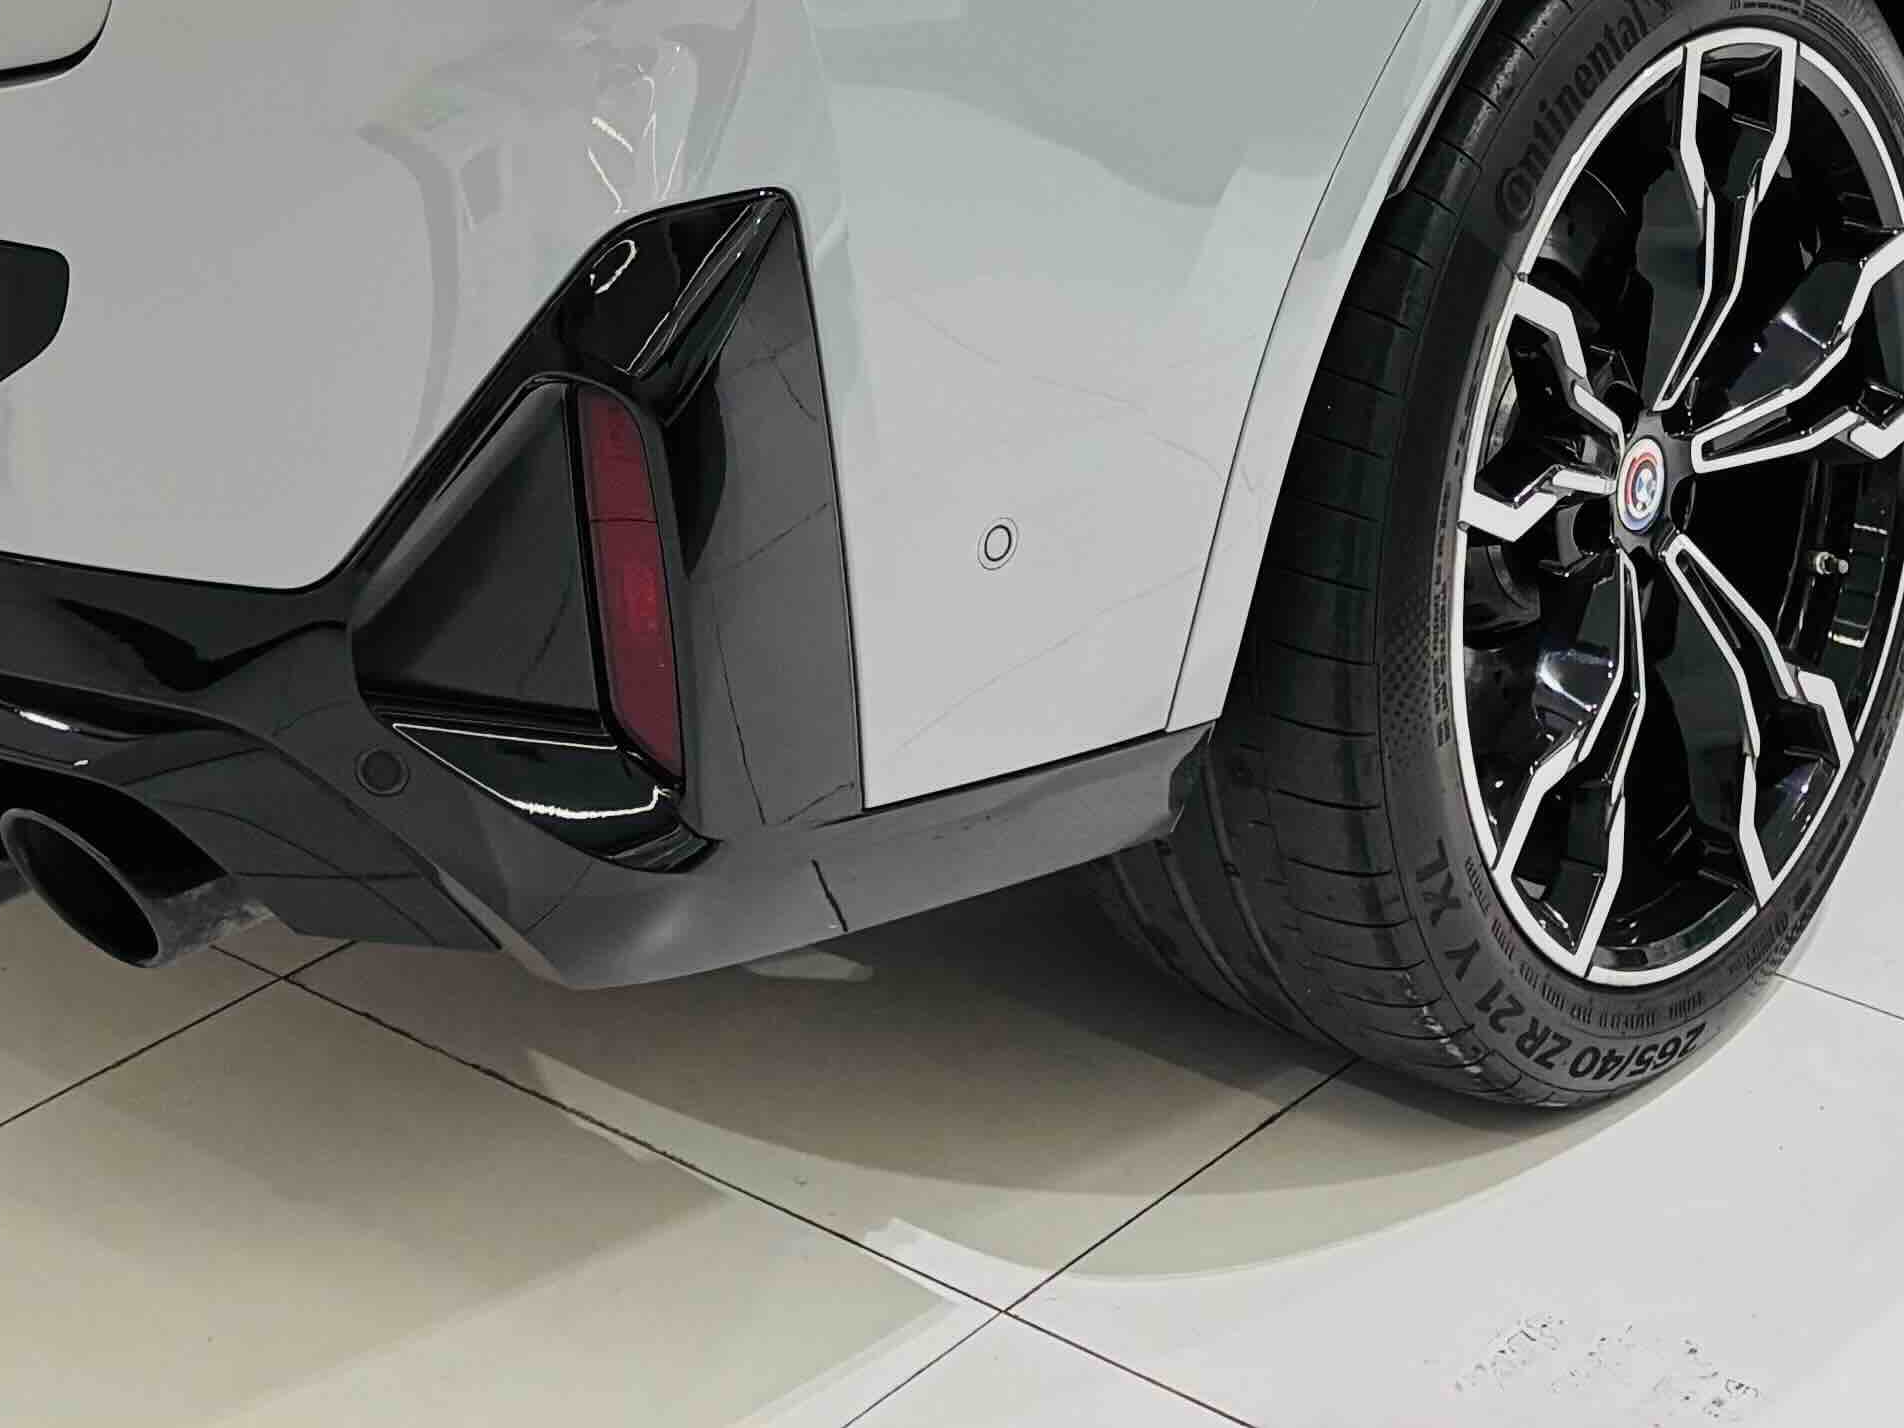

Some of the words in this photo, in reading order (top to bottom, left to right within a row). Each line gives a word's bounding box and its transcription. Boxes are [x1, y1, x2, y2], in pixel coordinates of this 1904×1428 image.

[1414, 838, 1463, 927] XL
[1474, 980, 1526, 1035] 21
[1514, 1015, 1574, 1070] ZR
[1567, 1019, 1709, 1083] 265/40
